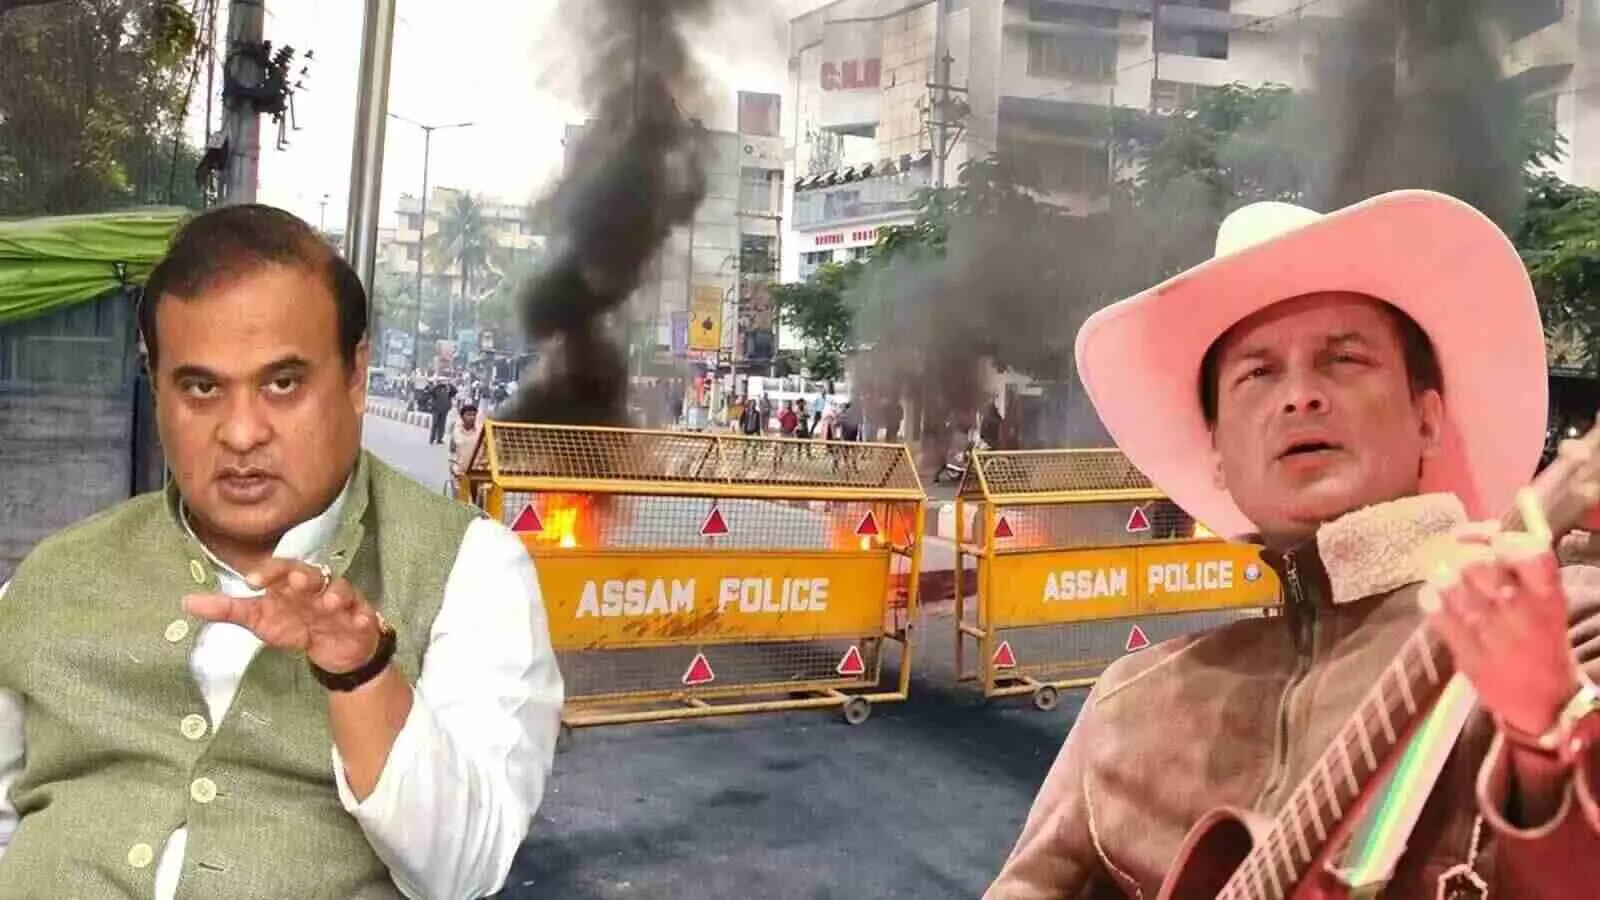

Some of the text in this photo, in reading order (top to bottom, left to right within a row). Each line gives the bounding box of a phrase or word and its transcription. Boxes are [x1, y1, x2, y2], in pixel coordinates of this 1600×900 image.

[576, 577, 828, 618] ASSAM POLICE
[1044, 560, 1233, 603] ASSAM POLICE
